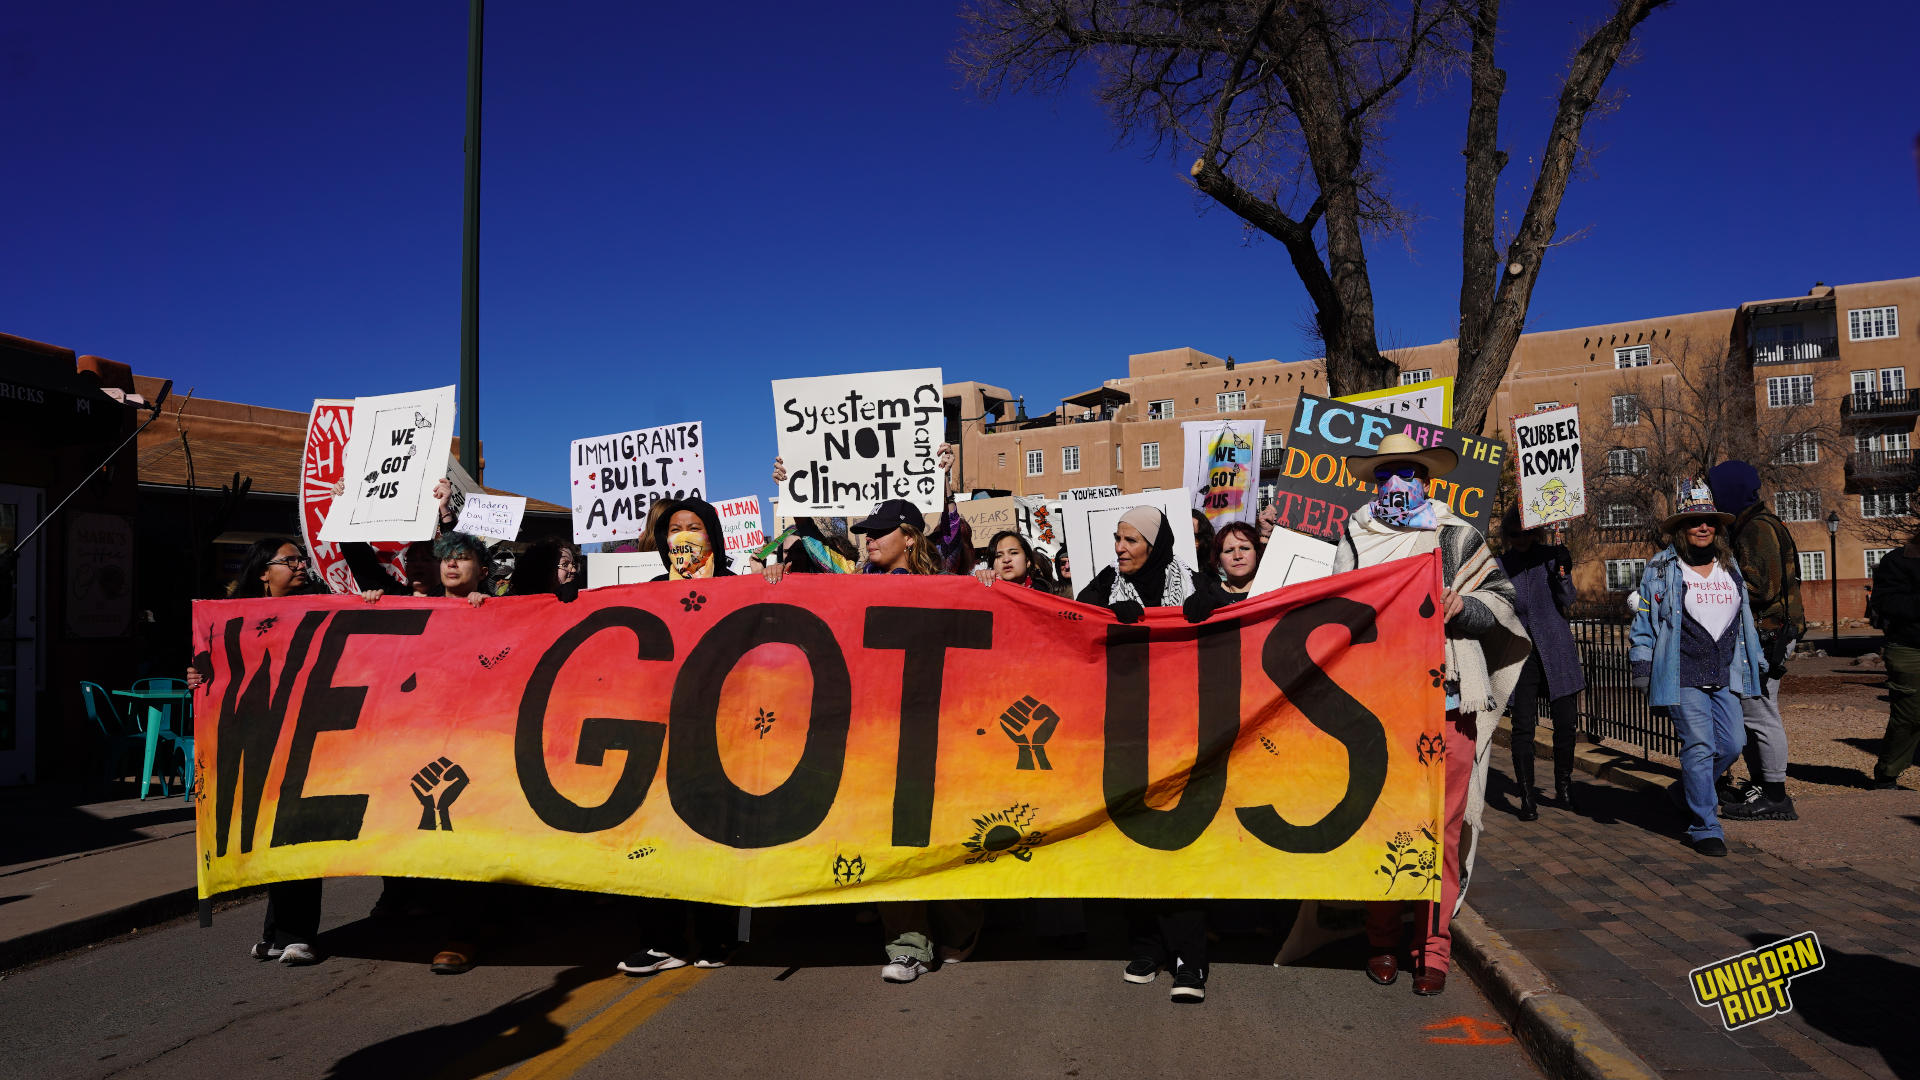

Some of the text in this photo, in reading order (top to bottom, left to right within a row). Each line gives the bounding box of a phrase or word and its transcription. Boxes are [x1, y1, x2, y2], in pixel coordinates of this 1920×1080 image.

[783, 389, 910, 435] Syestem
[391, 428, 416, 446] WE
[1294, 397, 1503, 465] ICE ARE THE
[1517, 418, 1579, 449] RUBBER
[578, 424, 699, 466] IMMIGRANTS
[824, 422, 901, 461] NOT
[1215, 446, 1236, 463] WE
[1522, 443, 1579, 477] ROOM!
[380, 455, 411, 474] GOT
[601, 457, 673, 493] BUILT
[1211, 471, 1237, 487] GOT
[379, 481, 400, 499] US
[467, 497, 508, 510] Modern
[722, 498, 760, 518] HUMAN
[1212, 493, 1229, 509] US
[744, 520, 756, 529] ON
[77, 530, 127, 546] MARK'S
[740, 530, 765, 548] LAND
[676, 557, 684, 565] TO
[1696, 593, 1733, 604] B!TCH
[216, 597, 1389, 858] WE GOT US
